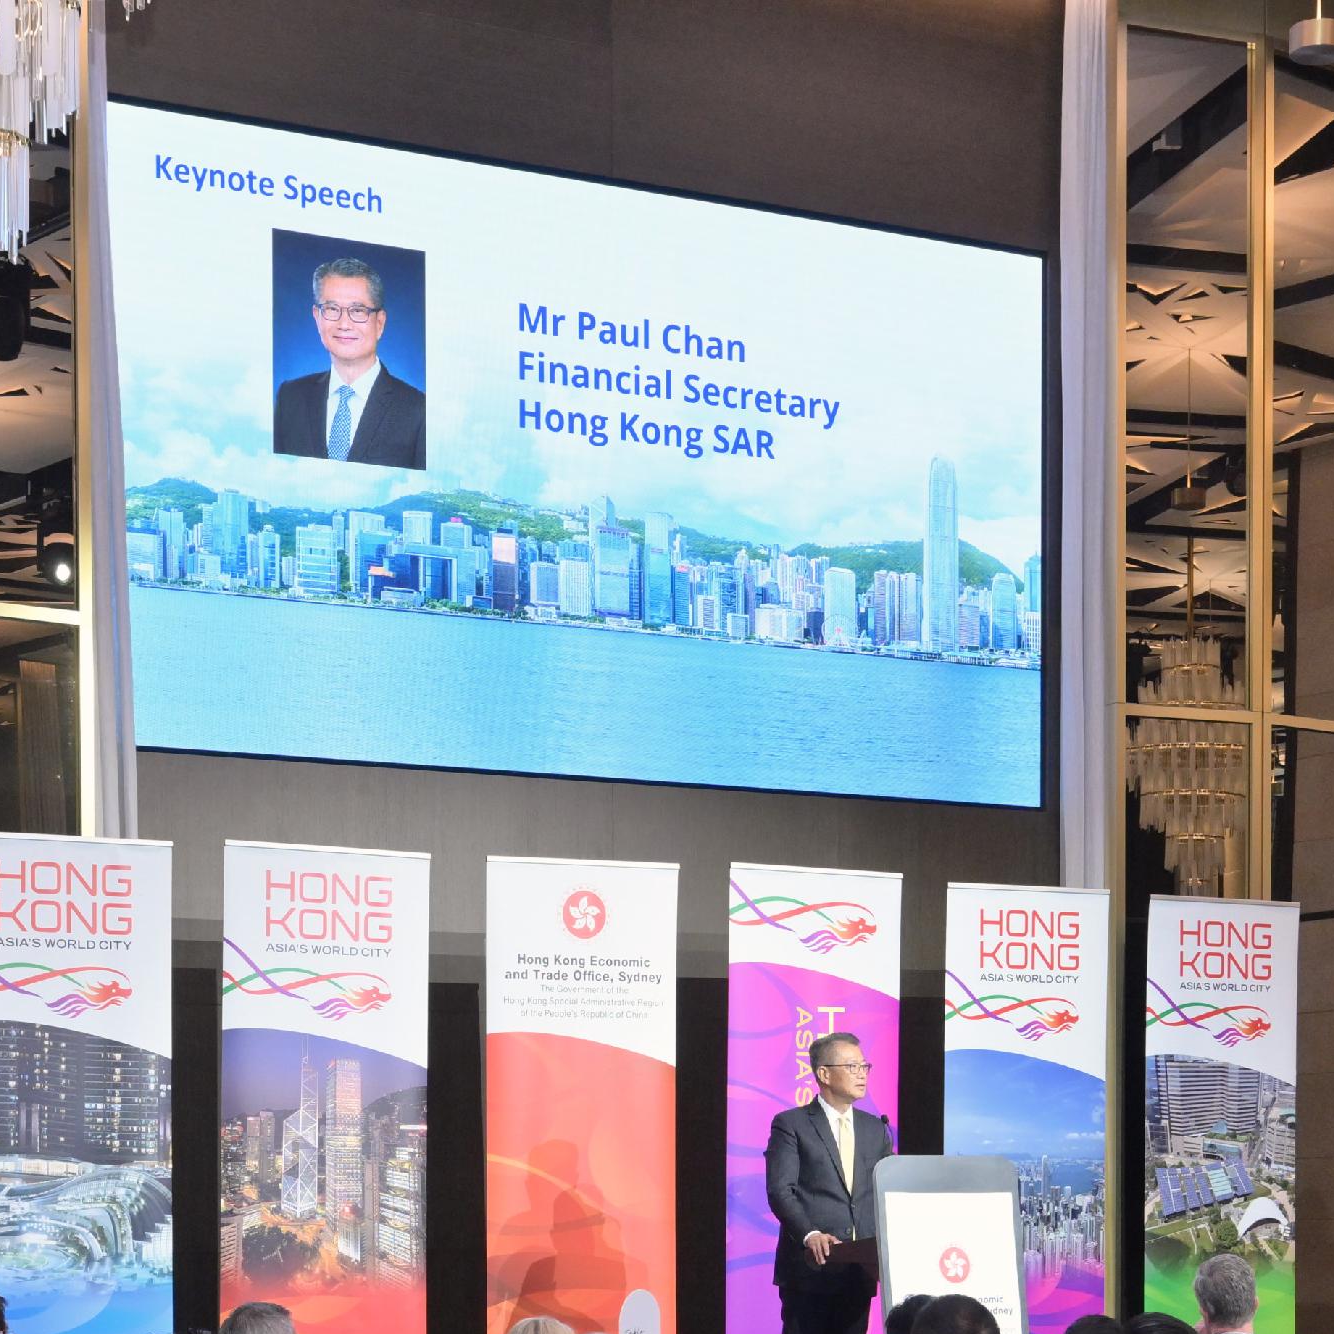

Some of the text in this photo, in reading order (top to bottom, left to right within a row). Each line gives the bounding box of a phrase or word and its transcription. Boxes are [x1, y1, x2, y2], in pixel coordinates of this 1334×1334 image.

[155, 154, 383, 214] Keynote Speech
[518, 302, 746, 363] Mr Paul Chan
[518, 350, 840, 430] Financial Secretary
[518, 398, 775, 460] Hong Kong SAR
[265, 869, 393, 908] HONG
[265, 906, 393, 944] KONG
[980, 908, 1080, 940] HONG
[1179, 919, 1272, 950] HONG
[44, 937, 96, 950] WORLD
[98, 940, 132, 951] CITY
[266, 943, 392, 959] ASIA'S WORLD CITY
[979, 940, 1080, 971] KONG
[517, 953, 651, 969] Hong Kong Economic
[1179, 950, 1272, 981] KONG
[504, 969, 663, 985] and Trade Office, Sydney
[1015, 974, 1055, 984] WORLD
[1055, 974, 1080, 984] CITY
[1212, 982, 1248, 992] WORLD
[1249, 983, 1272, 993] CITY
[795, 1006, 814, 1107] ASIA'S
